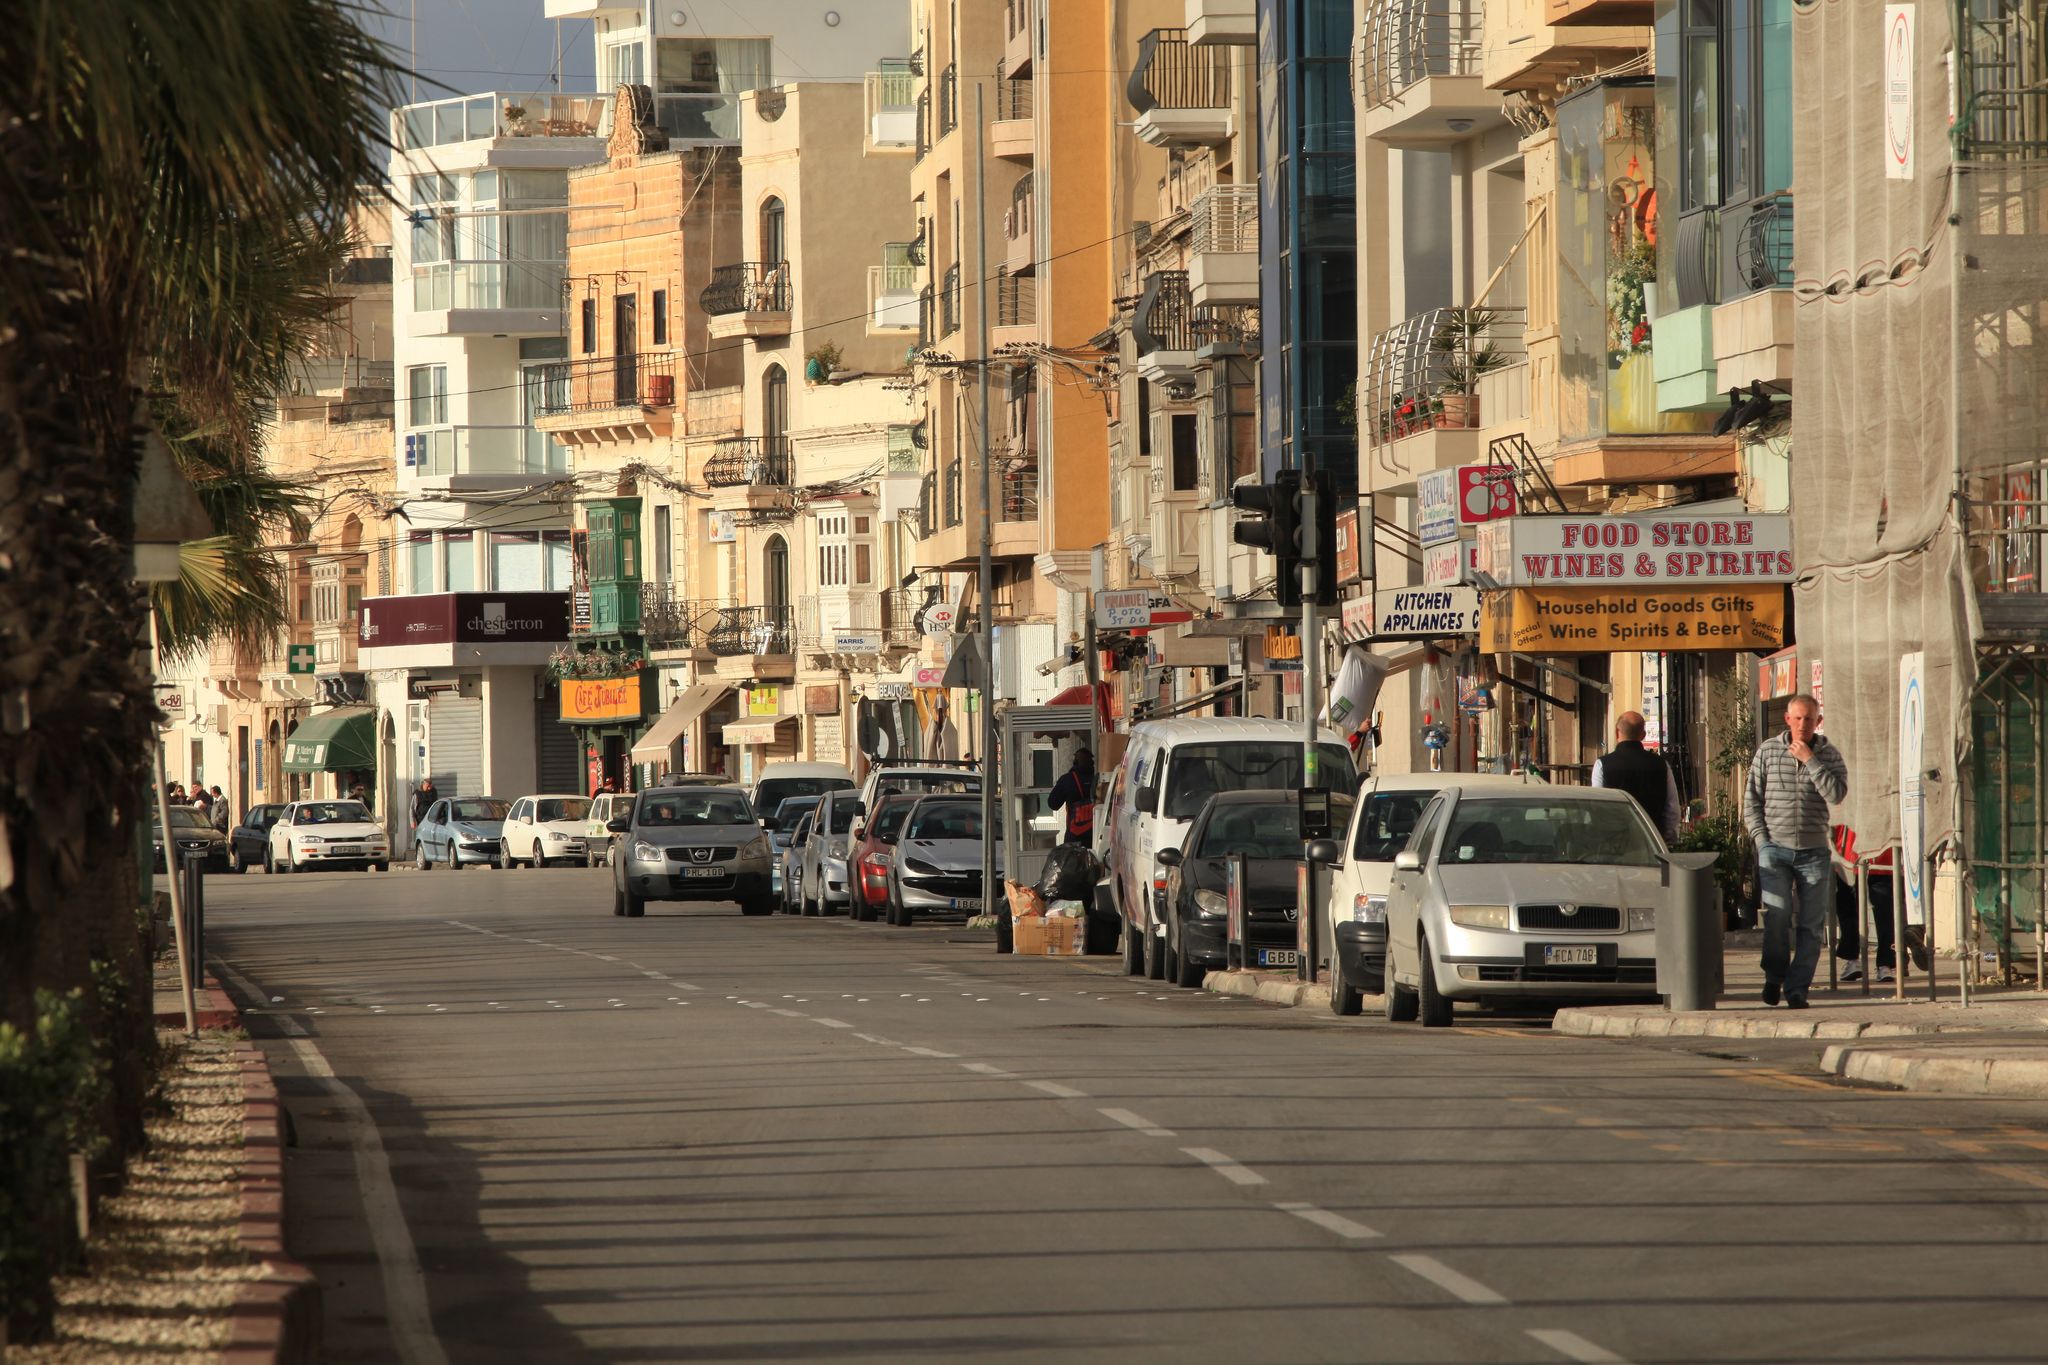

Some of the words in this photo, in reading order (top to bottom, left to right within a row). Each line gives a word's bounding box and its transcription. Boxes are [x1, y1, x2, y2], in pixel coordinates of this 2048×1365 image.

[1562, 523, 1640, 548] FOOD
[1652, 520, 1754, 547] STORE
[1522, 553, 1625, 578] WINES
[1634, 552, 1657, 577] &
[1666, 550, 1795, 577] SPIRITS
[1394, 592, 1452, 611] KITCHEN
[1537, 598, 1637, 615] Household
[1644, 598, 1704, 613] Goods
[1711, 597, 1754, 612] Gifts
[467, 615, 543, 630] chesterton
[1383, 612, 1465, 631] APPLIANCES
[1513, 621, 1541, 639] Special
[1751, 618, 1783, 635] Special
[1517, 633, 1543, 646] Offers
[1550, 624, 1597, 639] Wine
[1610, 622, 1669, 641] Spirits
[1676, 622, 1689, 636] &
[1697, 621, 1741, 636] Beer
[575, 685, 593, 714] CAFÉ
[879, 683, 904, 698] BEAUTY
[1268, 951, 1296, 964] GBB
